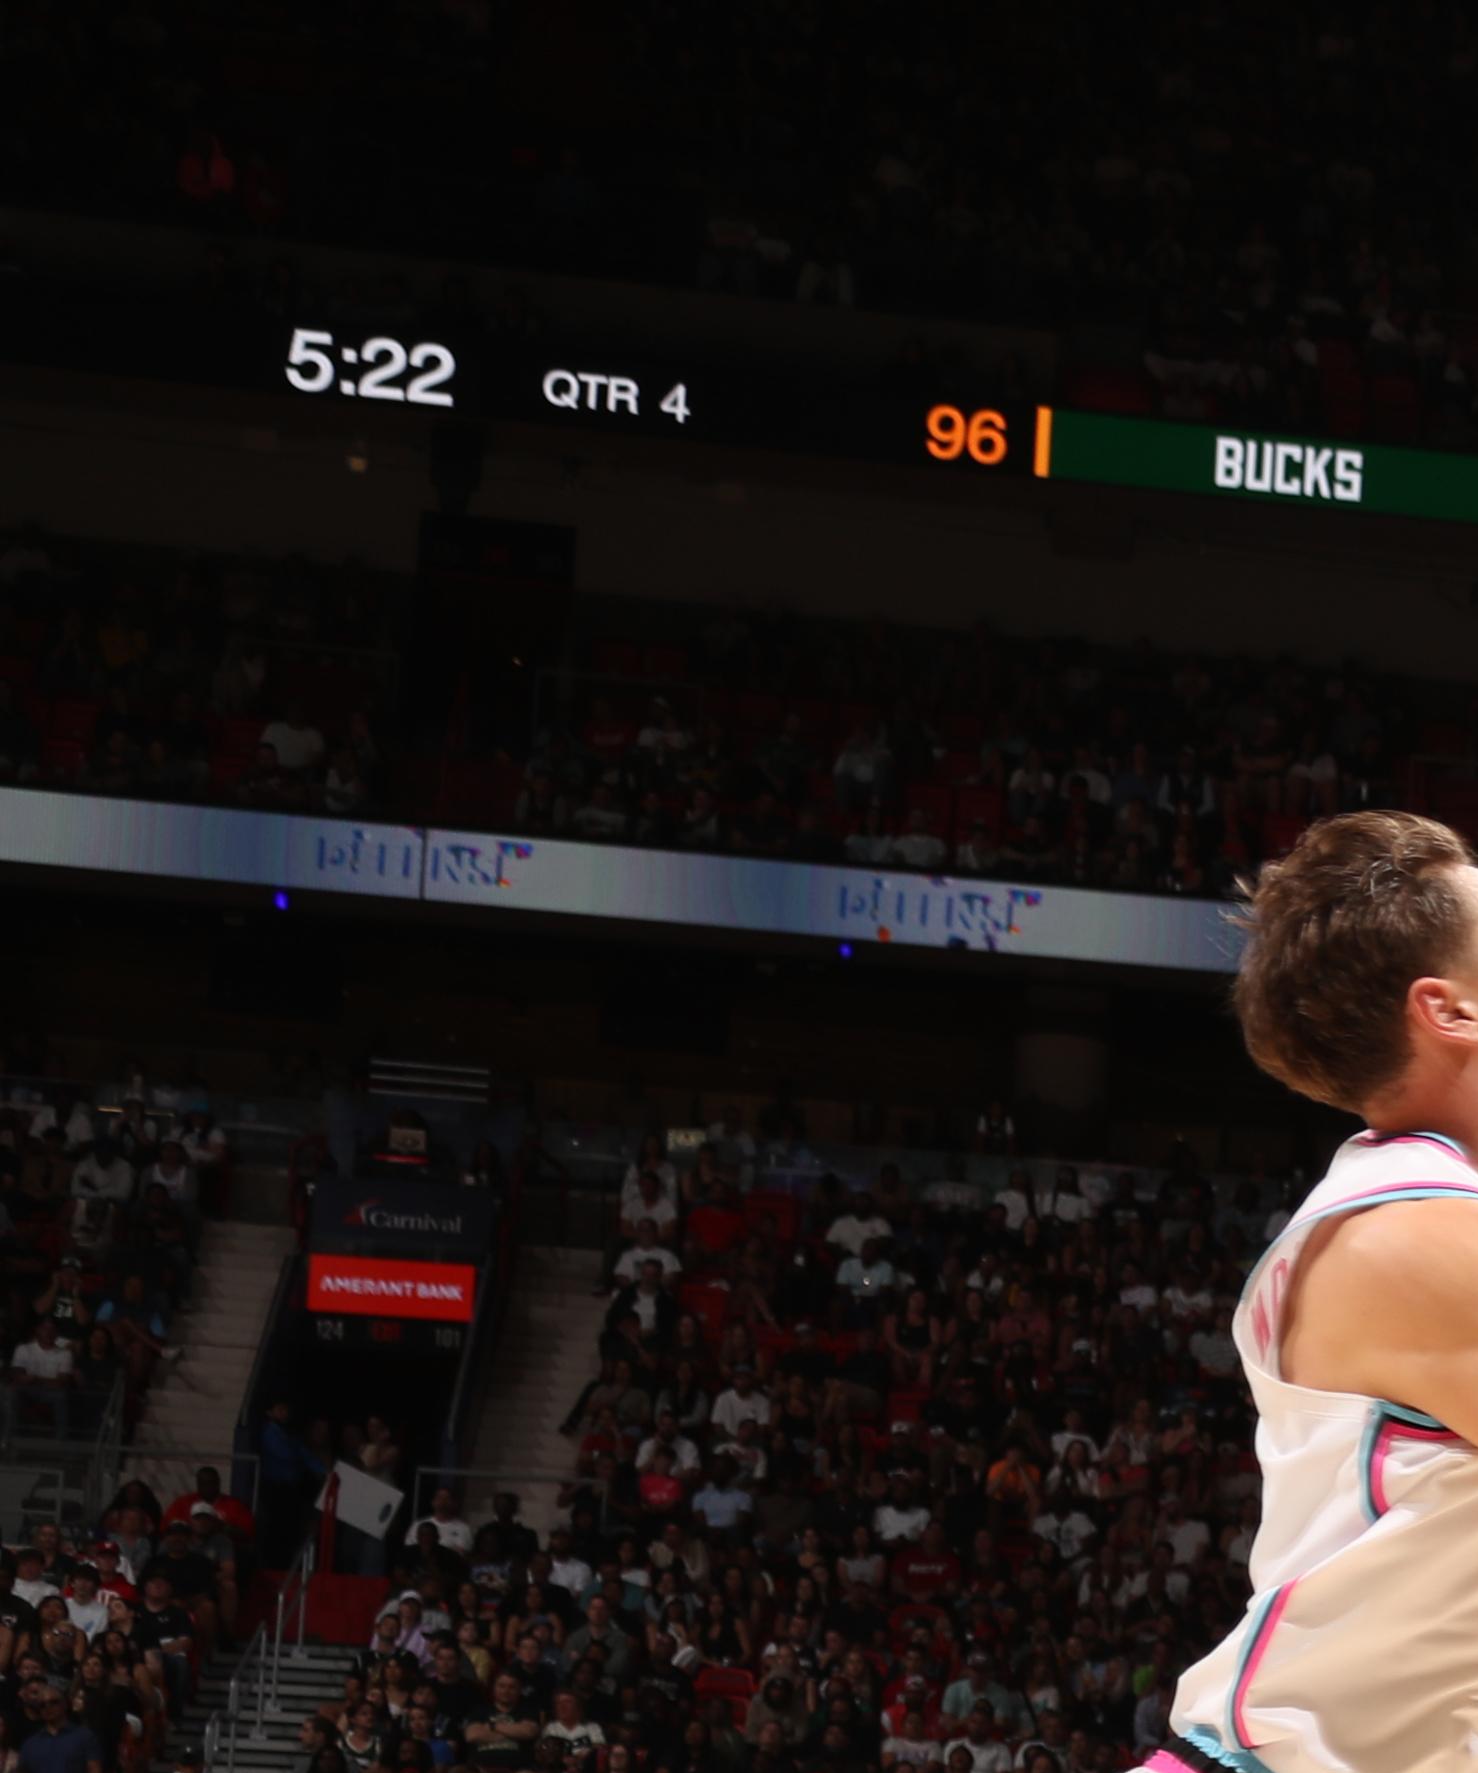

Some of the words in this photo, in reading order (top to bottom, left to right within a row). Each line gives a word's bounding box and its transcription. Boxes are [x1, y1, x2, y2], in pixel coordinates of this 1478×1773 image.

[285, 328, 456, 407] 5:22
[542, 370, 640, 415] QTR
[660, 383, 691, 424] 4
[926, 404, 1008, 465] 96
[1214, 436, 1363, 502] BUCKS
[370, 1209, 463, 1235] Carnival
[320, 1274, 415, 1298] AMERANT
[415, 1281, 464, 1302] BANK
